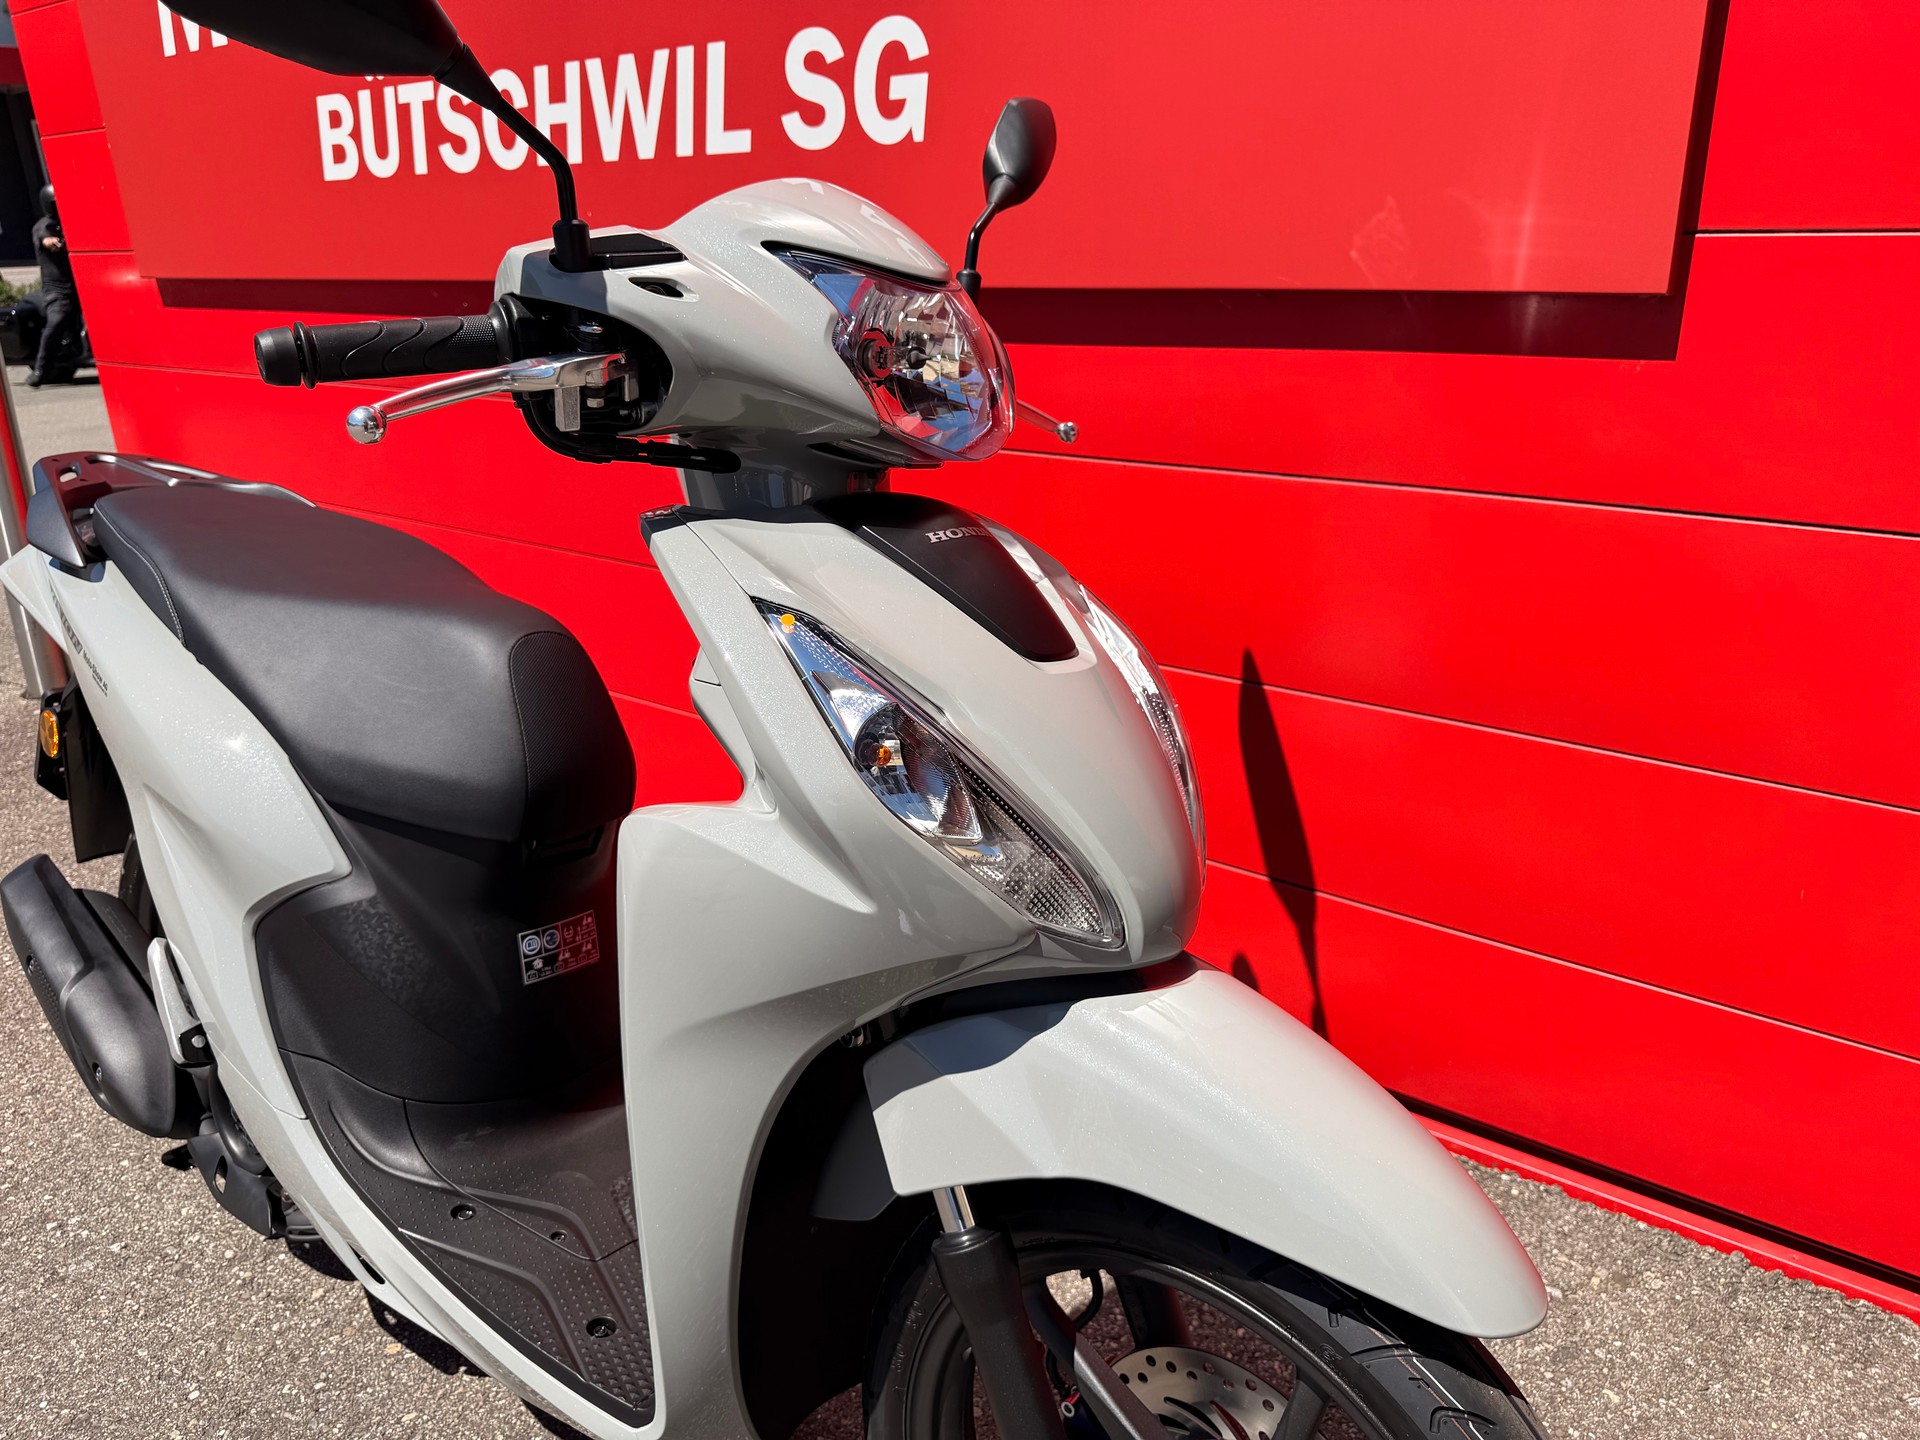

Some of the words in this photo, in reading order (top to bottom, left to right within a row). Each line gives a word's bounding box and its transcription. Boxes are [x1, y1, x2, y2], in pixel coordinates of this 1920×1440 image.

[316, 41, 752, 181] BÜTSCHWIL
[780, 15, 930, 150] SG
[925, 526, 991, 543] HOND
